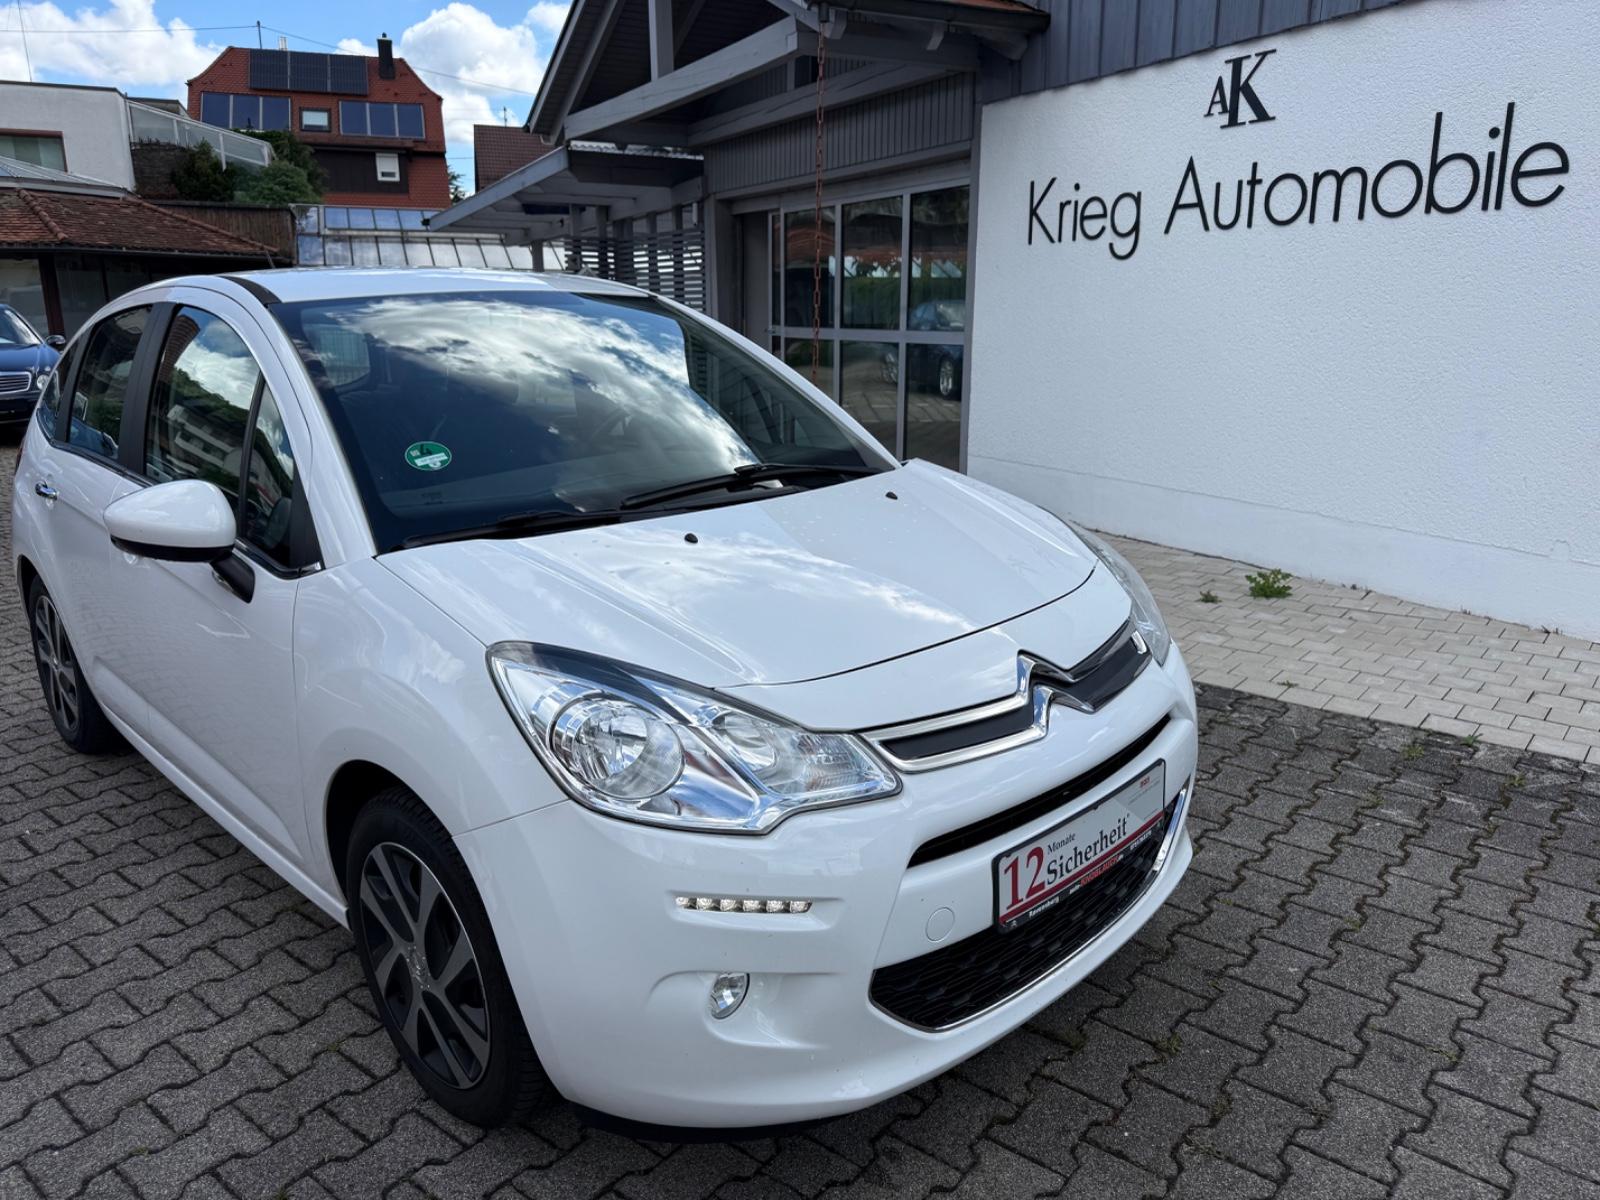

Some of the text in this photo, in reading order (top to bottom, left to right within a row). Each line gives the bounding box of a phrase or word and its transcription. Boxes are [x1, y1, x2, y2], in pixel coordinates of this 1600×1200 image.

[1028, 102, 1570, 260] Krieg Automobile
[1047, 833, 1076, 855] Monate
[1004, 847, 1045, 910] 12
